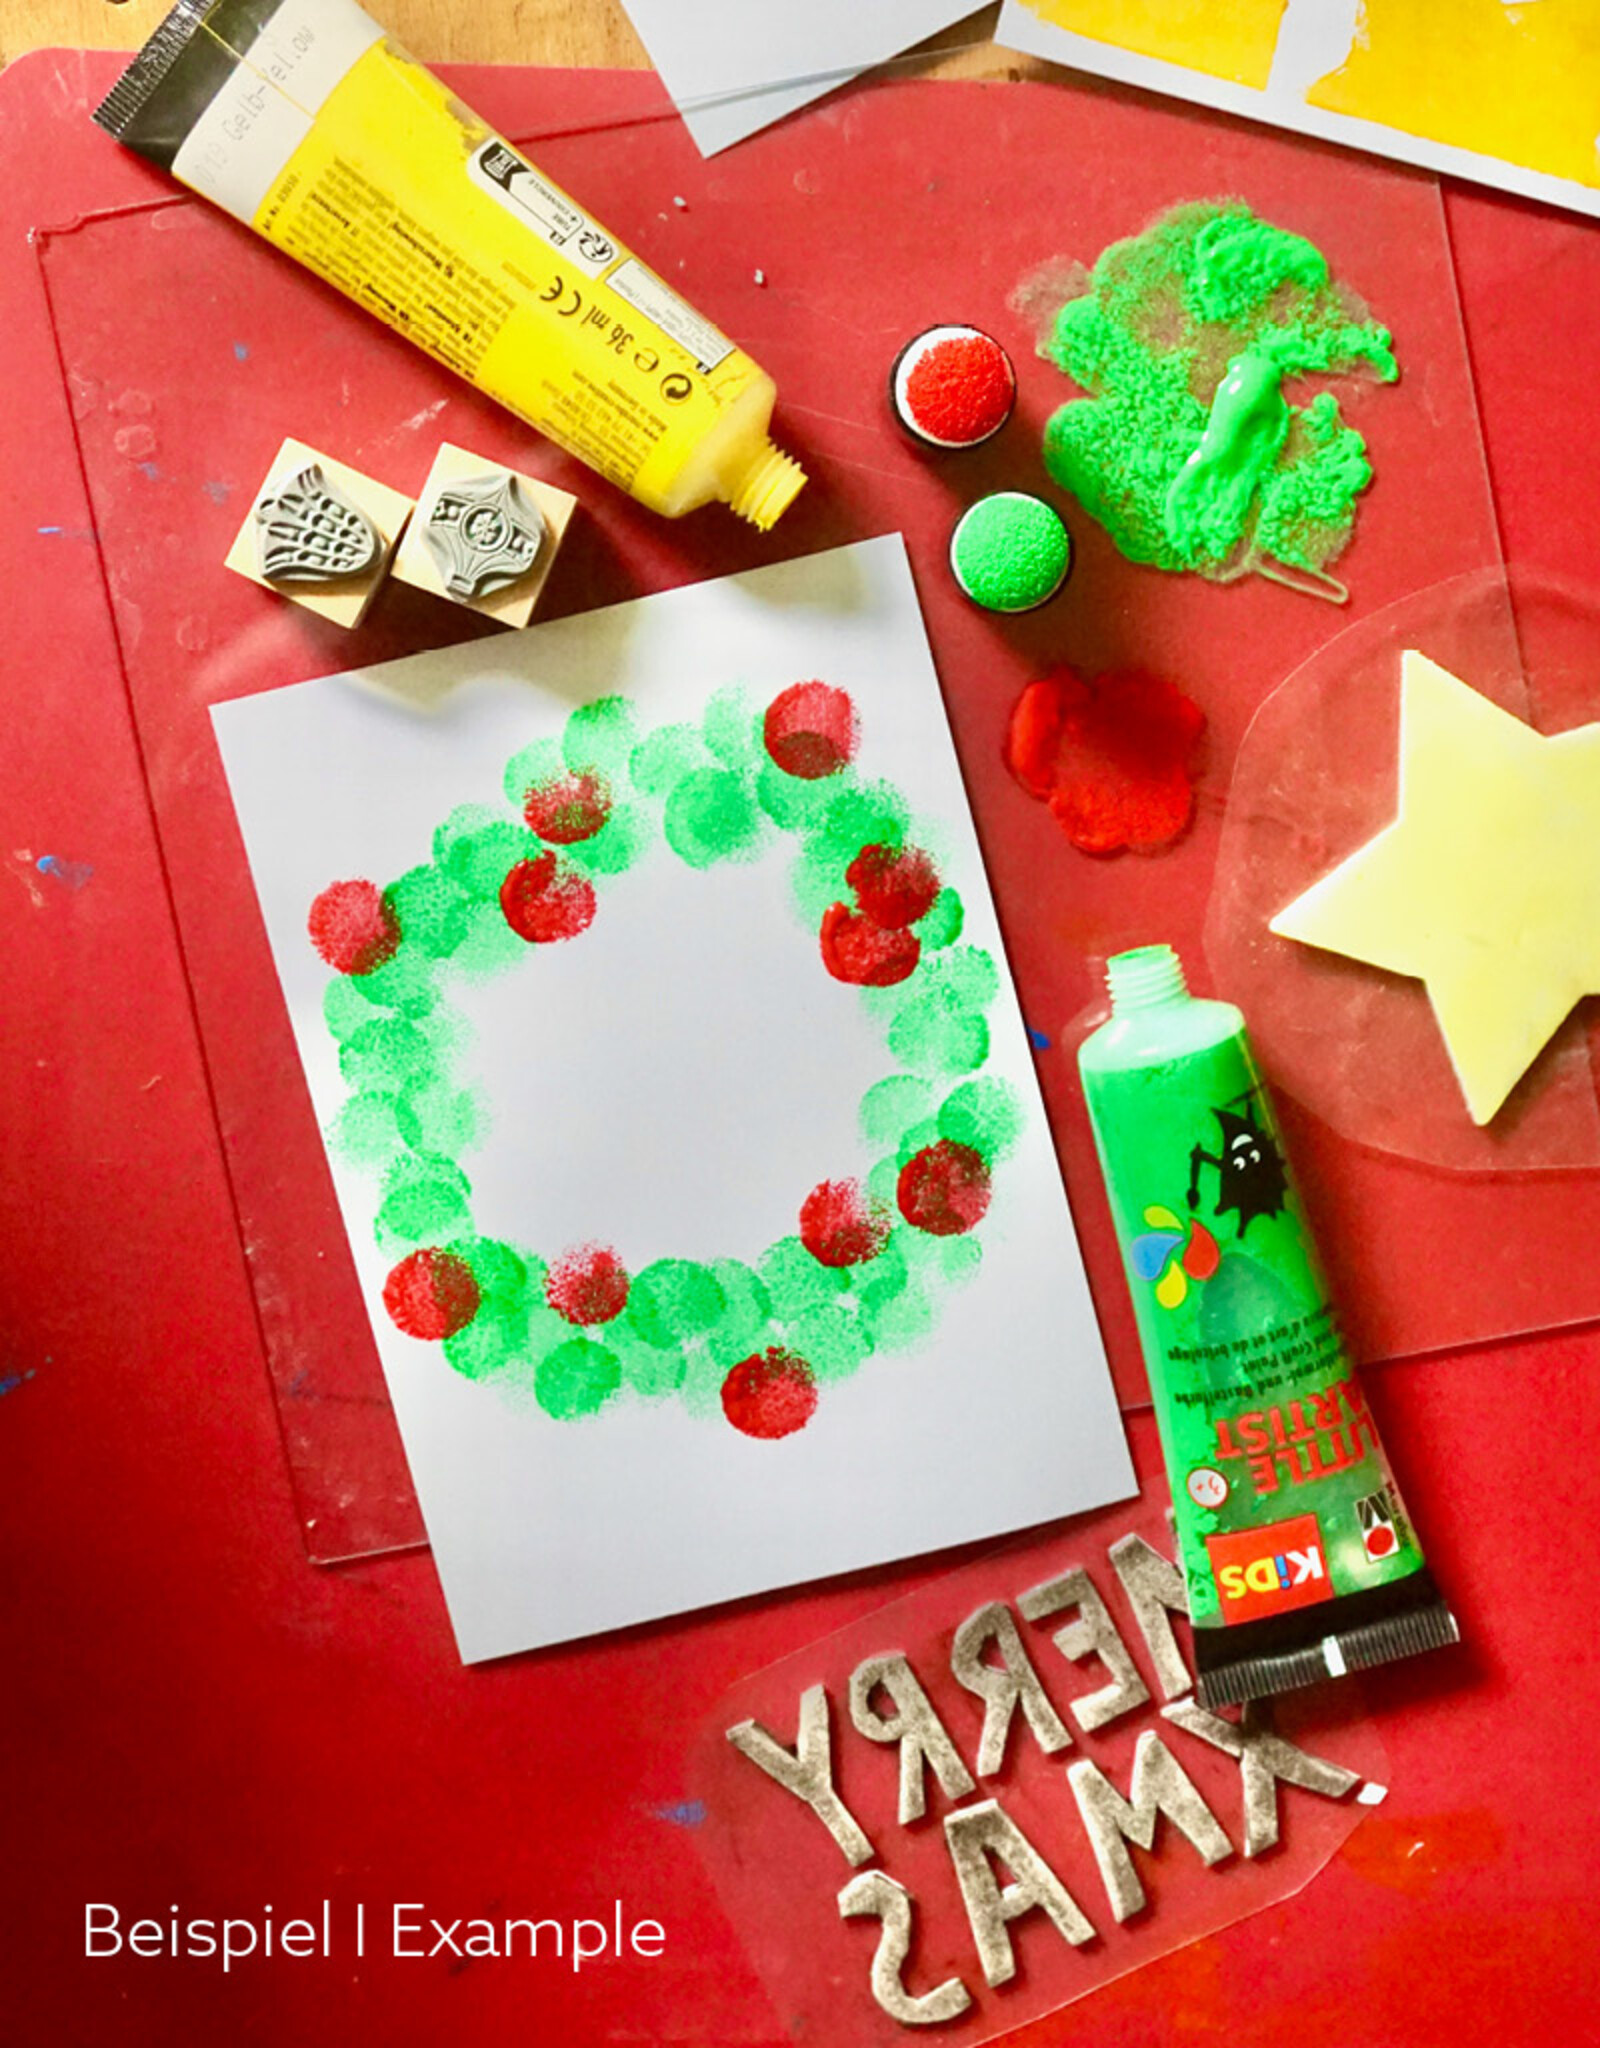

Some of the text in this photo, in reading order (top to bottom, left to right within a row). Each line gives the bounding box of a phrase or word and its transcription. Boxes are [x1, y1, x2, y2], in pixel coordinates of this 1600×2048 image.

[580, 304, 611, 330] ml
[605, 323, 635, 355] 36
[1214, 1376, 1367, 1460] ARTIST
[1248, 1410, 1380, 1495] LITTLE
[1219, 1545, 1324, 1599] KiDS
